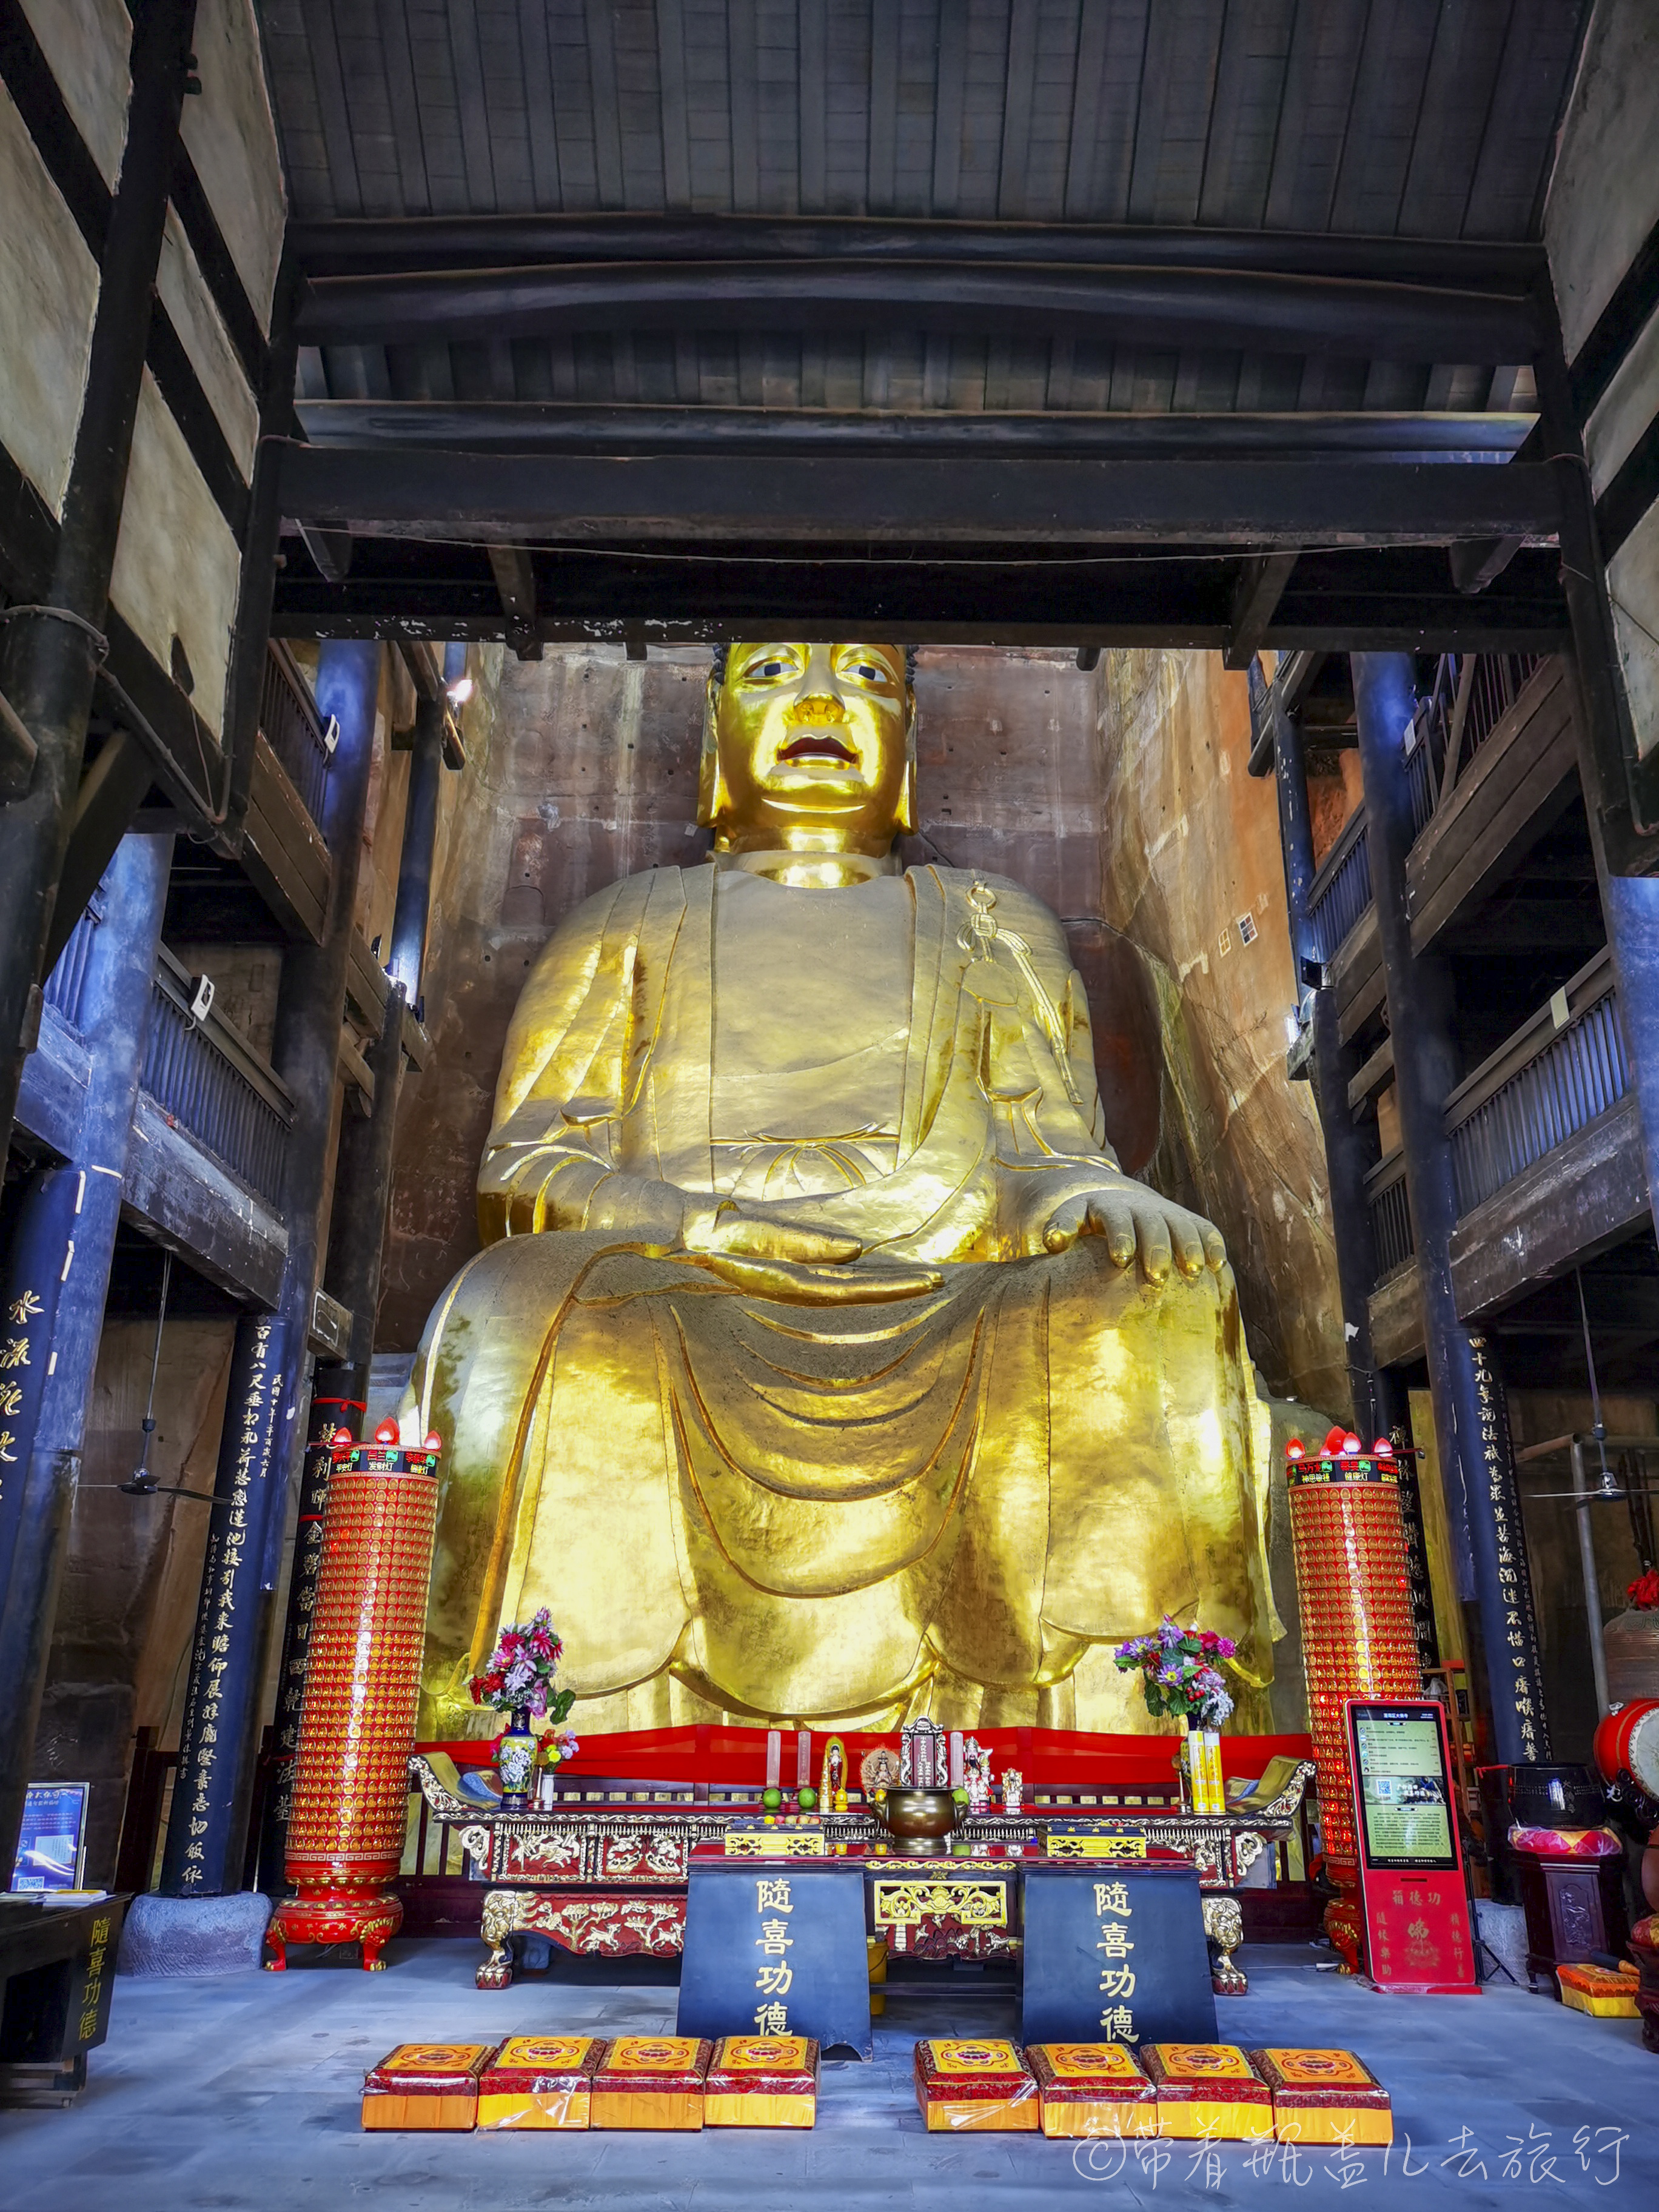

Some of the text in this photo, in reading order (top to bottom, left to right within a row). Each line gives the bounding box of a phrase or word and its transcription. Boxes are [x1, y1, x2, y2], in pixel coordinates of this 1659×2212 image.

[336, 1463, 353, 1472] 平安灯
[369, 1462, 395, 1472] 发财灯
[78, 1916, 111, 2041] 隨喜功德
[754, 1879, 796, 2036] 隨喜功德
[1093, 1882, 1141, 2043] 隨喜功德
